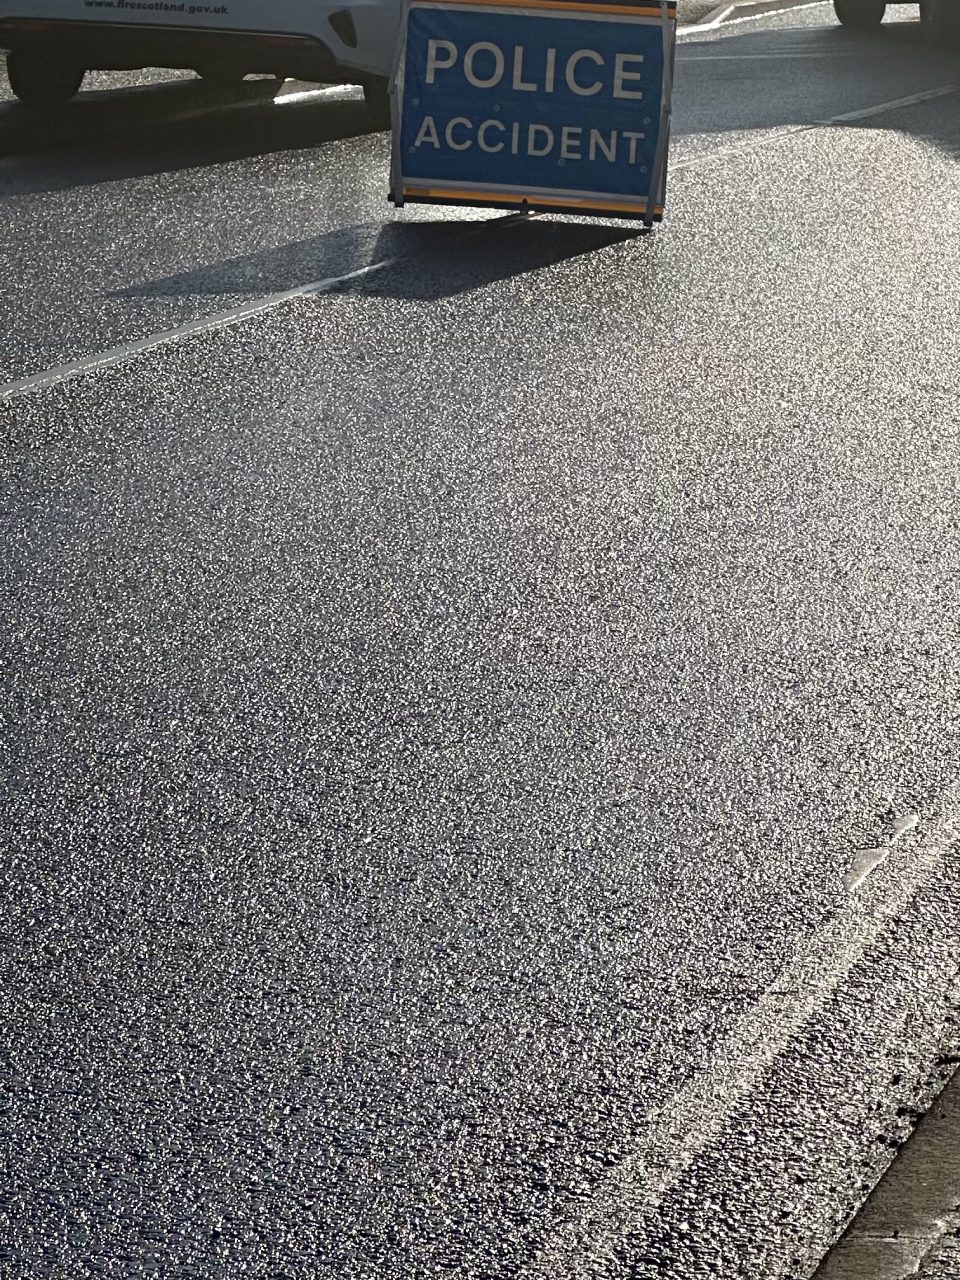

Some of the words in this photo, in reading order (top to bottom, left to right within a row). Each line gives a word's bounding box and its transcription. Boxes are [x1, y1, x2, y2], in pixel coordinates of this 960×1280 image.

[83, 0, 229, 15] www.firescotland.gov.uk
[424, 39, 645, 100] POLICE
[413, 115, 646, 165] ACCIDENT
